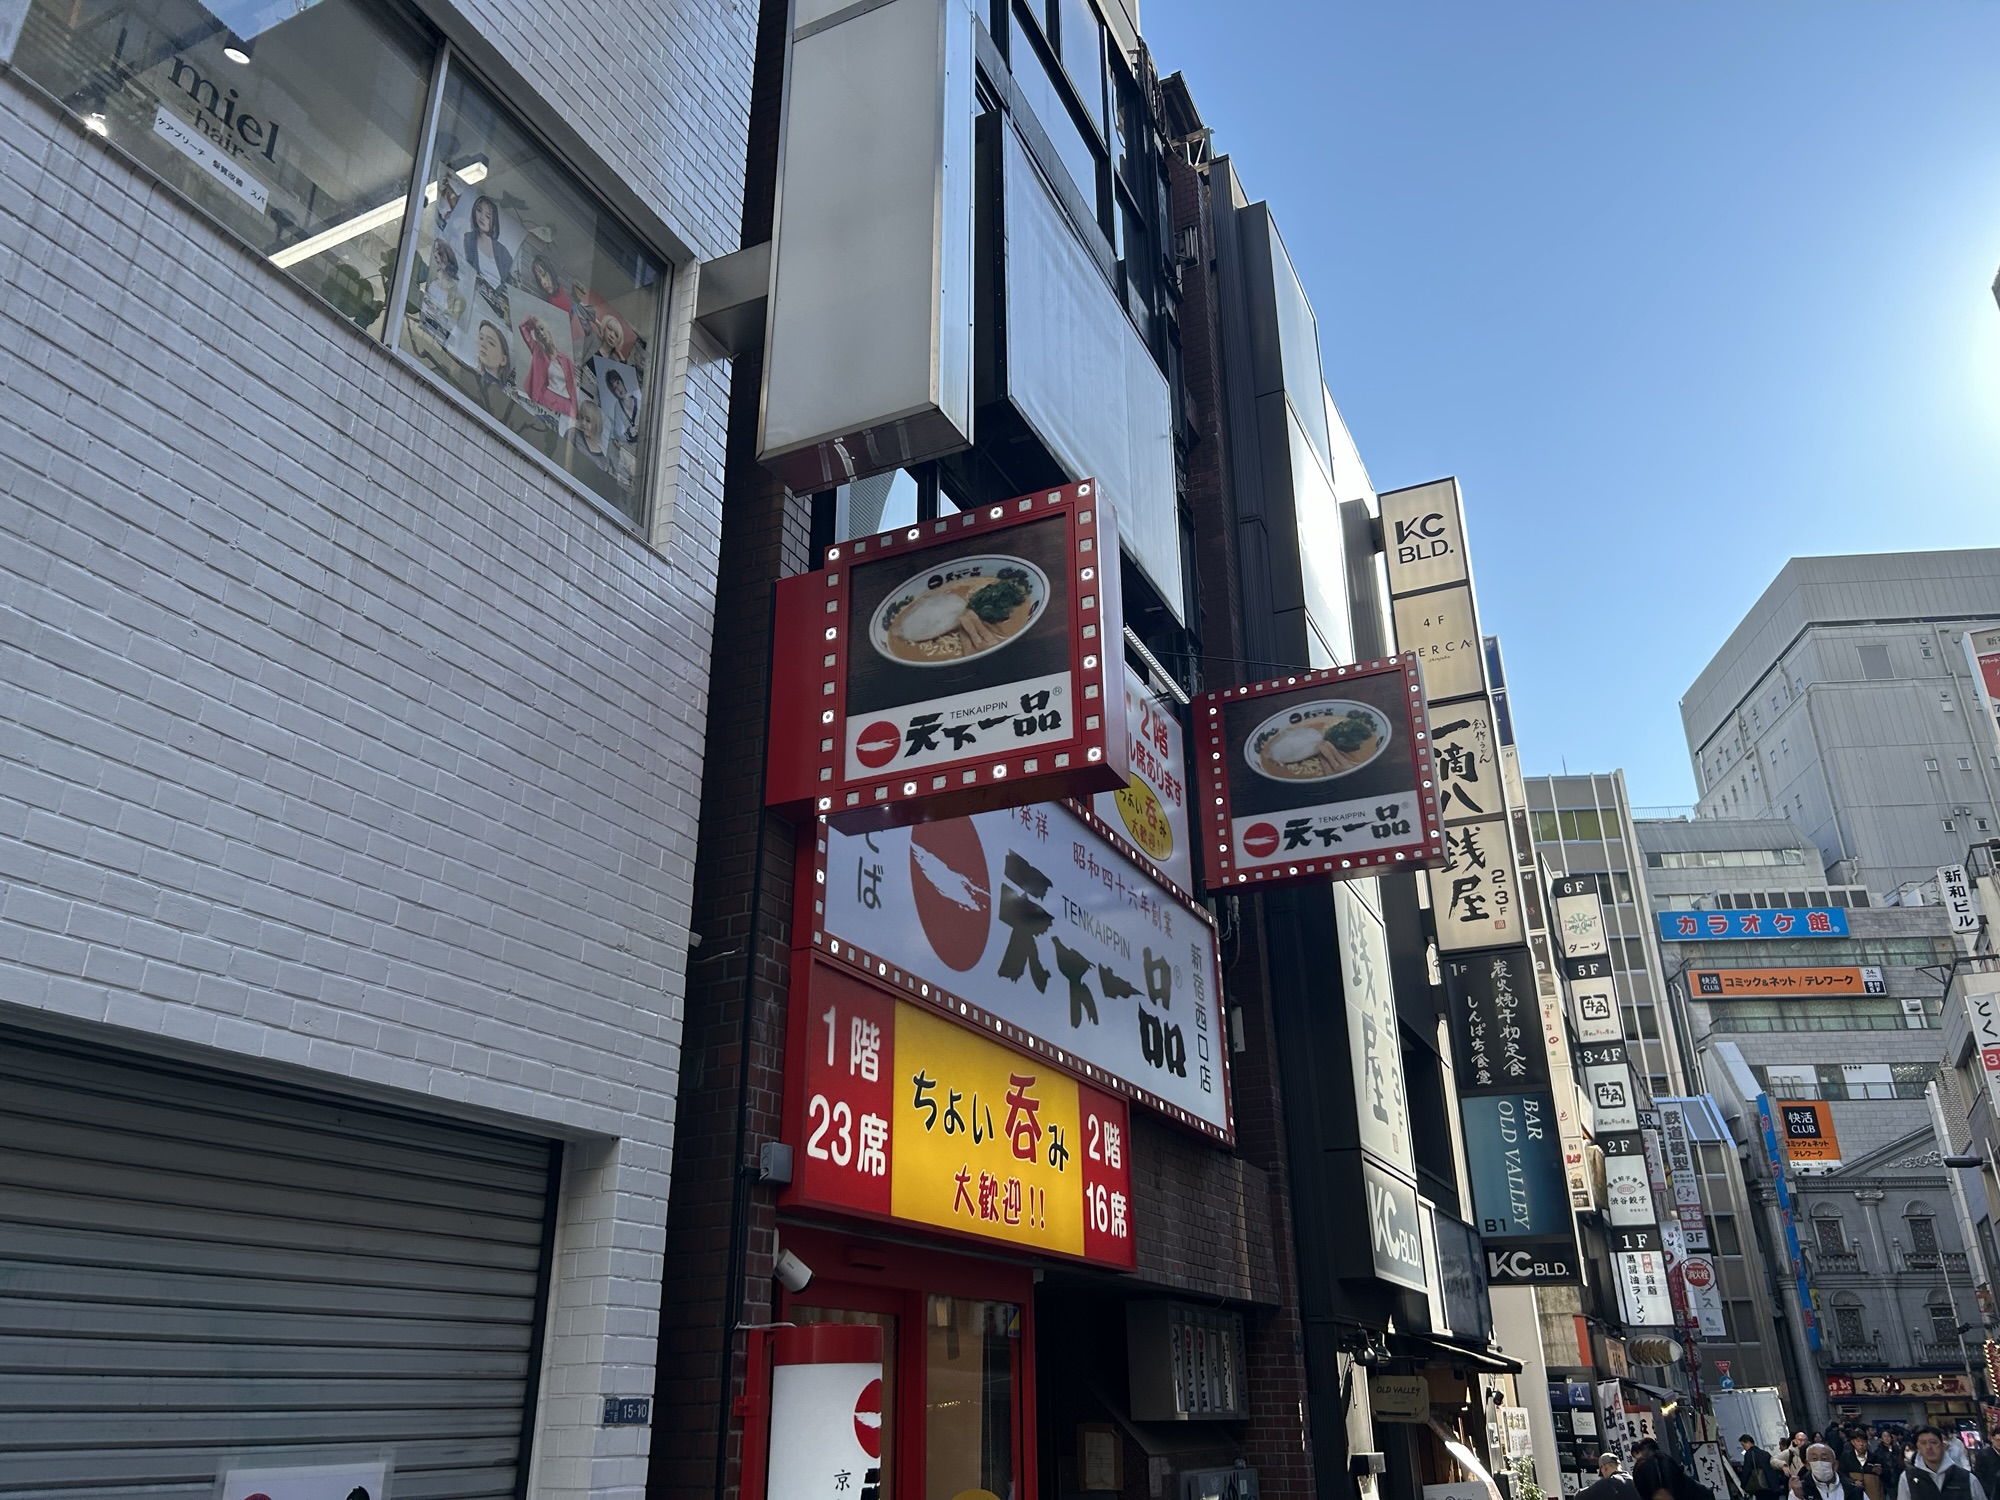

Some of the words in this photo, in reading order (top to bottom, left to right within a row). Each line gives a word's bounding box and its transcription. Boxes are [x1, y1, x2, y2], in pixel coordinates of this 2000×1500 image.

[167, 55, 280, 165] miel
[1394, 512, 1446, 546] KC
[1397, 539, 1454, 565] BLD.
[903, 689, 1063, 758] 天下一品
[949, 700, 1008, 720] TENKAIPPIN
[1283, 803, 1412, 852] 天下一品
[1317, 810, 1366, 824] TENKAIPPIN
[1072, 841, 1175, 940] 昭和四十六年創業
[1944, 869, 1975, 928] 新和ビル
[1061, 894, 1132, 961] TENKAIPPIN
[1676, 912, 1831, 935] カラオケ館
[997, 848, 1188, 1078] 天下一品
[1568, 941, 1601, 954] ダーツ
[1450, 963, 1467, 977] 1F
[1701, 977, 1719, 986] 快活
[1702, 984, 1720, 992] CLUB
[1804, 975, 1854, 987] テレワーク
[1190, 942, 1212, 1095] 新宿西口店
[822, 1005, 881, 1083] 1階
[1467, 995, 1493, 1085] しんぱち食堂
[1985, 1053, 2000, 1066] 3
[806, 1093, 889, 1178] 23席
[911, 1067, 1070, 1174] ちょい呑み
[1497, 1100, 1518, 1144] OLD
[1522, 1097, 1543, 1141] BAR
[1788, 1111, 1814, 1124] 快活
[1791, 1124, 1816, 1134] CLUB
[1087, 1112, 1122, 1170] 2階
[1663, 1110, 1691, 1171] 鉄道模型
[952, 1162, 1046, 1231] 大歓迎!!
[1504, 1147, 1531, 1231] VALLEY
[1610, 1195, 1647, 1205] 渋谷餃子
[1085, 1180, 1128, 1239] 16席
[1368, 1180, 1401, 1260] KC
[1398, 1226, 1422, 1269] BLD.
[1484, 1218, 1507, 1233] B1
[1686, 1232, 1704, 1243] 3F
[1487, 1250, 1534, 1278] KC
[1533, 1262, 1570, 1277] BLD.
[1686, 1269, 1709, 1280] 消火栓
[1376, 1386, 1392, 1394] OLD
[1393, 1386, 1421, 1395] VALLEY
[623, 1404, 648, 1419] 15-10
